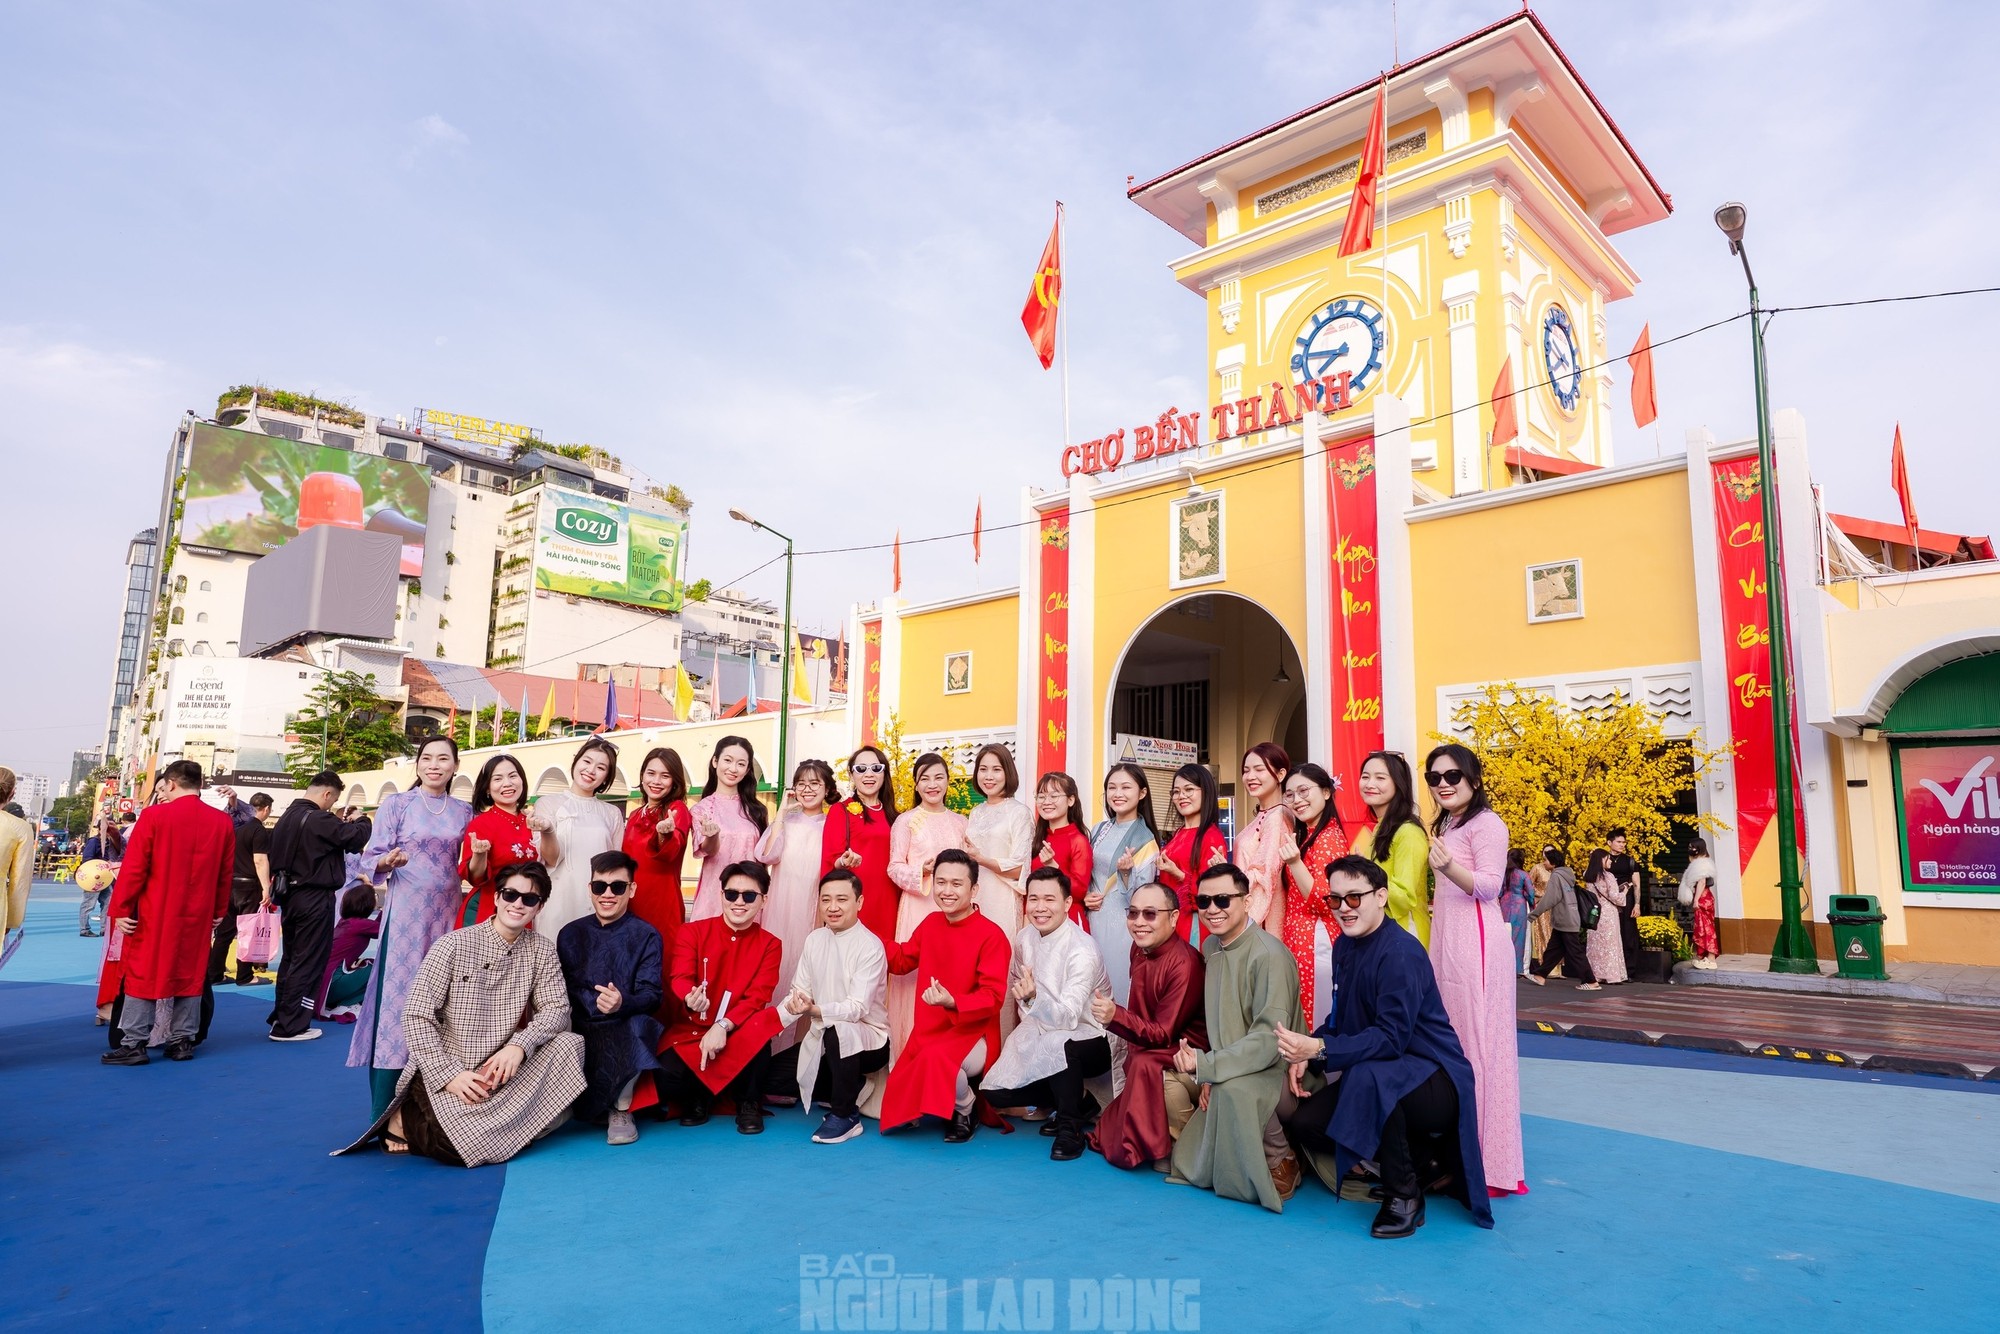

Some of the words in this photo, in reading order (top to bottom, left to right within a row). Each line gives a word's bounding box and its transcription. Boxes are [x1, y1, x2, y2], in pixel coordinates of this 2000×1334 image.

[426, 410, 532, 440] SILVERLAND
[1061, 427, 1125, 478] CHỢ
[1132, 405, 1200, 463] BẾN
[1211, 370, 1353, 441] THÀNH
[561, 511, 612, 541] Cozy
[580, 558, 599, 567] NHỊP
[1332, 532, 1378, 583] Happy
[631, 565, 660, 583] MATCHA
[190, 680, 224, 691] Legend
[1342, 696, 1380, 722] 2026
[1923, 823, 1961, 837] Ngân
[1964, 823, 2000, 836] hàng
[1940, 871, 1966, 879] 1900
[1968, 871, 1997, 880] 6608
[1971, 863, 1996, 871] (24/7)
